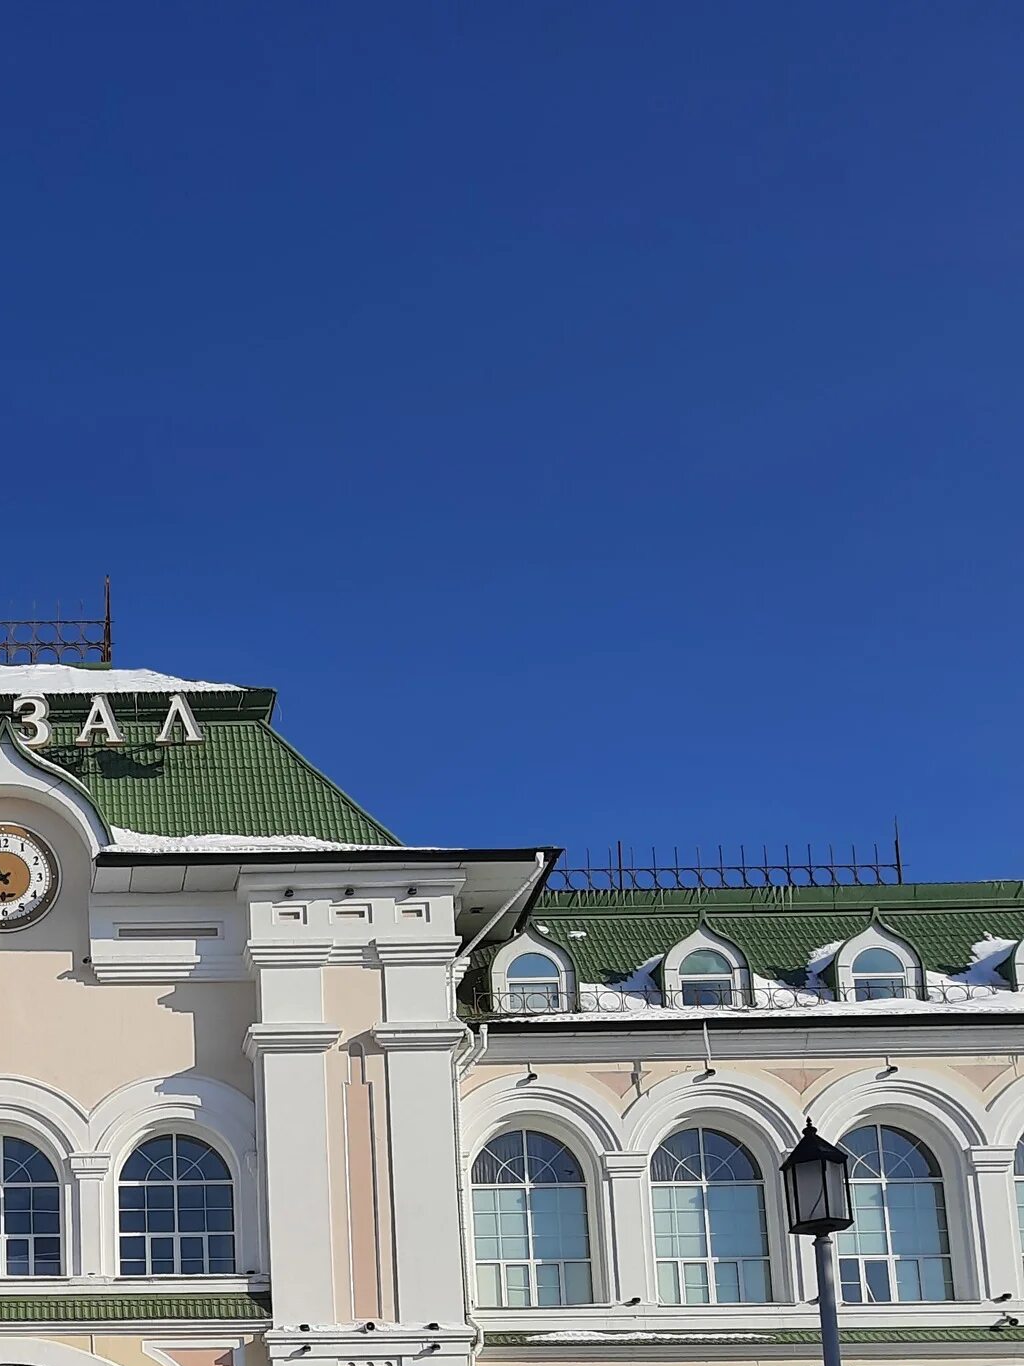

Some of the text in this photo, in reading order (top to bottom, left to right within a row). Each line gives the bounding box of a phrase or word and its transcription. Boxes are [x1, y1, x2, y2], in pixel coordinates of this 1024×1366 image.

[33, 856, 39, 865] 2
[36, 873, 43, 882] 3
[31, 890, 38, 899] 4
[18, 903, 25, 912] 5
[1, 908, 8, 917] 6
